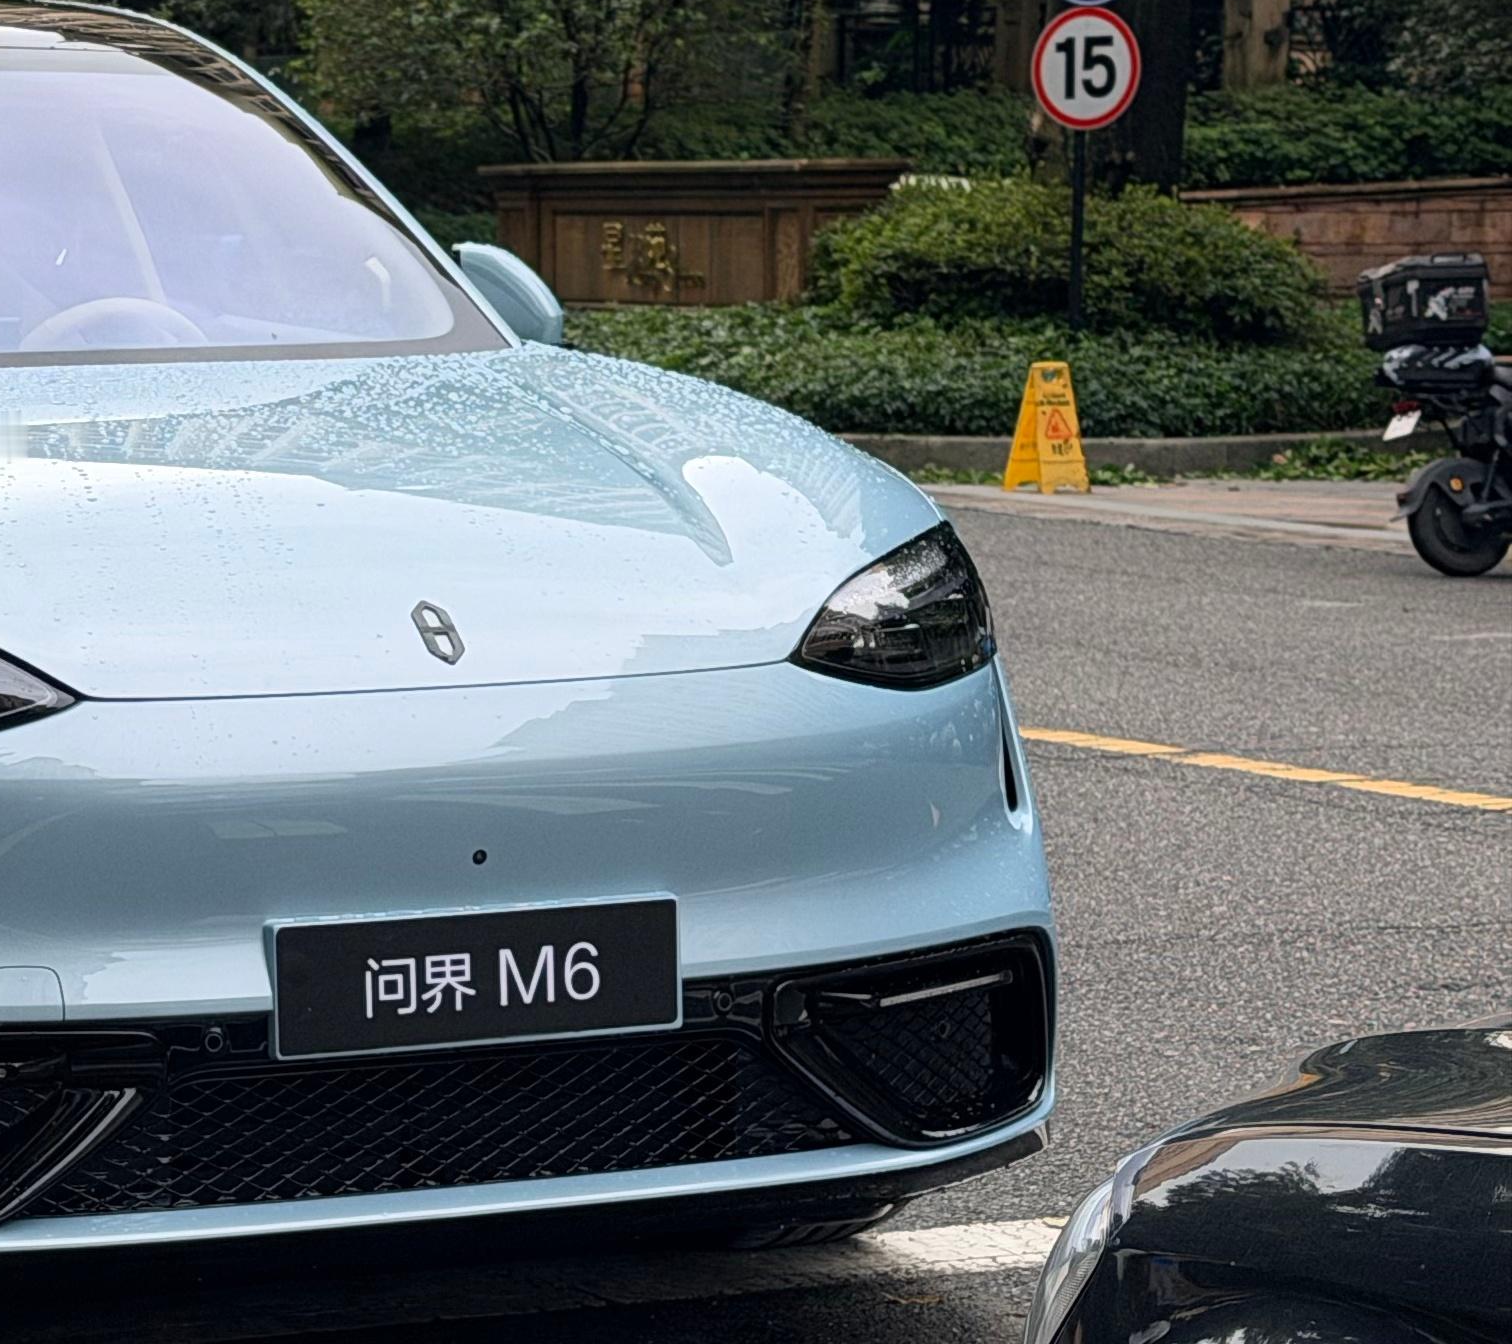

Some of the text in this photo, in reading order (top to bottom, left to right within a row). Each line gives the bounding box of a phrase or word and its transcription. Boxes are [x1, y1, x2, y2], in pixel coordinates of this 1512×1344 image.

[1055, 35, 1117, 100] 15
[365, 941, 601, 1019] 问界 M6
